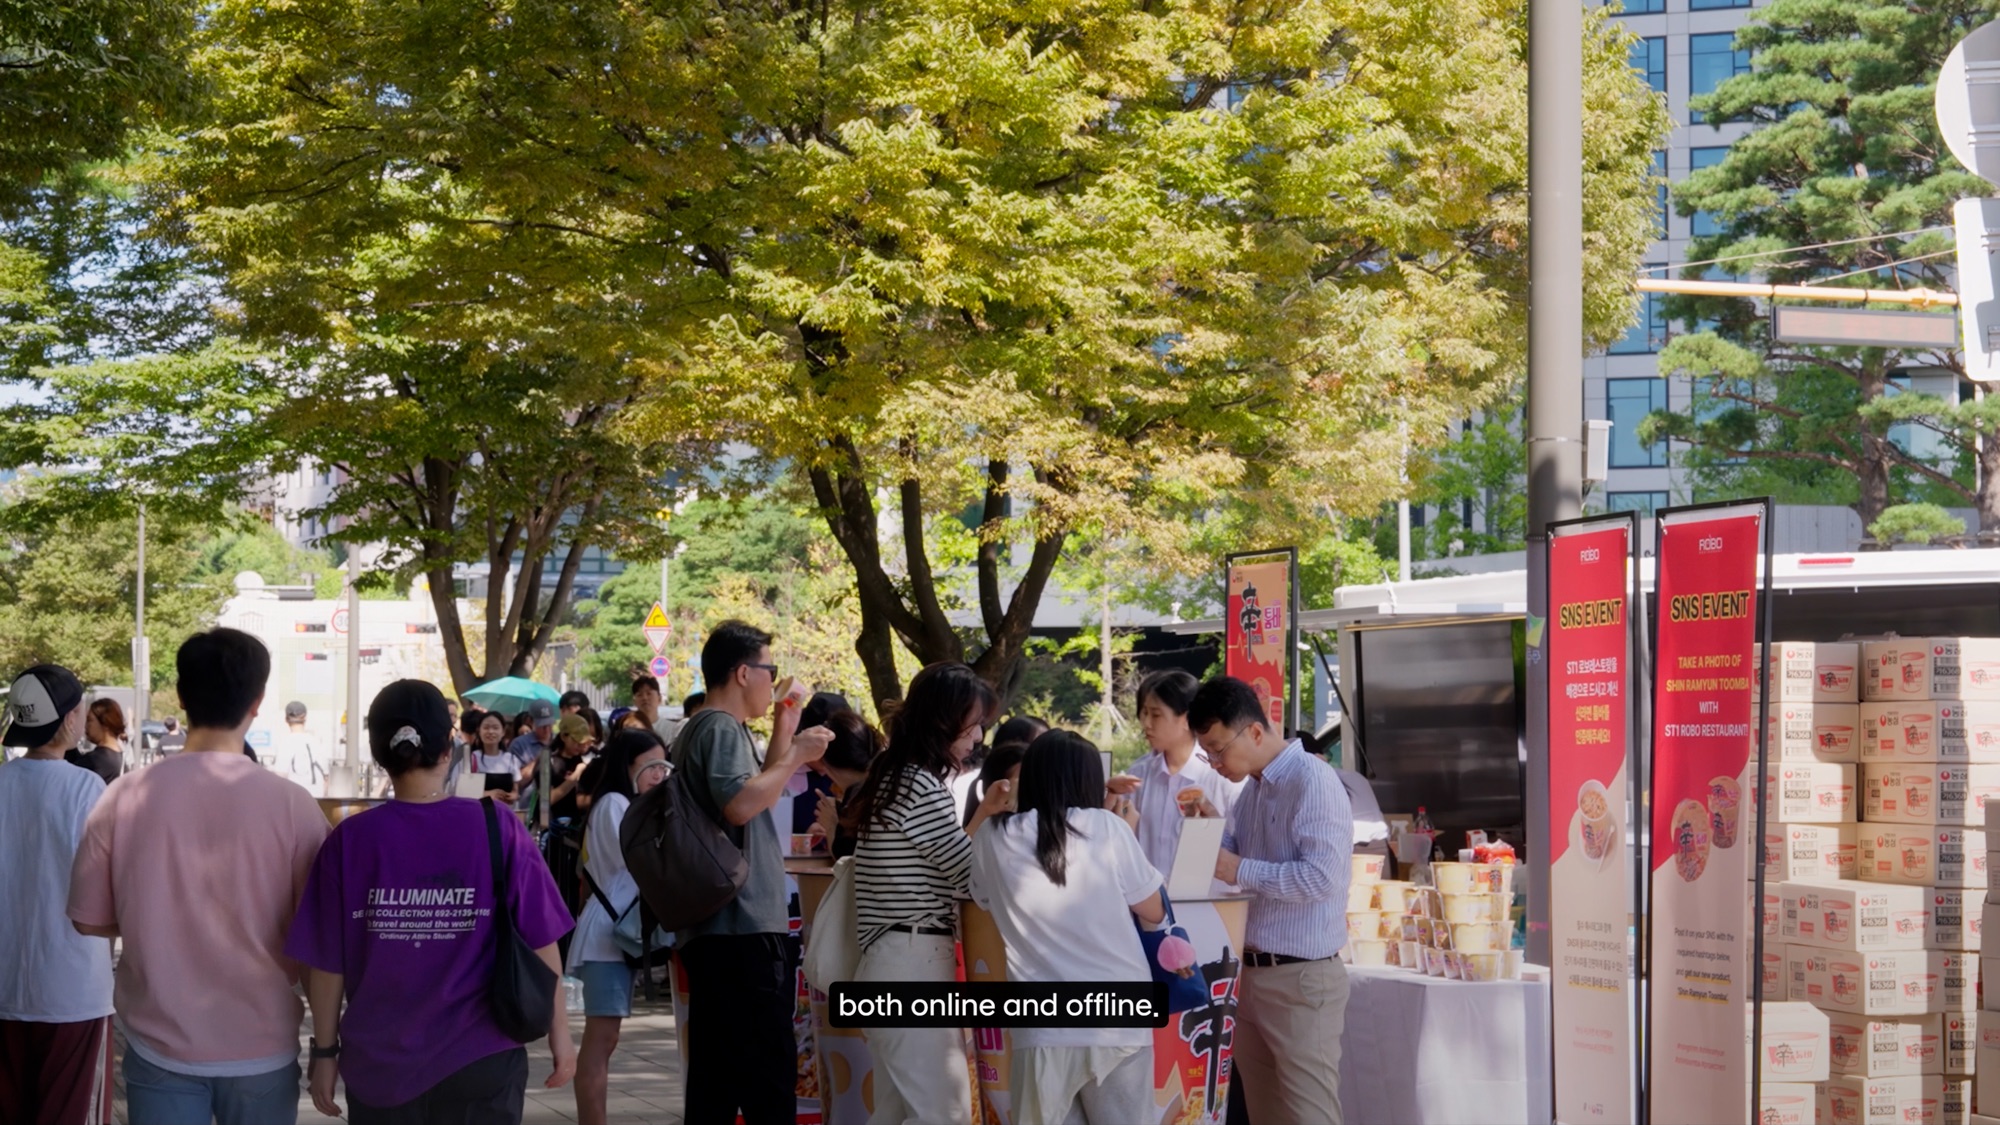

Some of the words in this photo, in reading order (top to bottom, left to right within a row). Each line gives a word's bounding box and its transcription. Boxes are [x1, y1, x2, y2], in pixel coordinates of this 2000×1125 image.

[1671, 594, 1699, 622] SNS
[1701, 590, 1750, 620] EVENT
[1560, 603, 1582, 629] SNS
[1584, 598, 1622, 627] EVENT
[1566, 661, 1578, 675] ST1
[1678, 656, 1696, 668] TAKE
[1698, 656, 1703, 668] A
[1705, 655, 1730, 668] PHOTO
[1731, 655, 1741, 666] OF
[1666, 680, 1684, 692] SHIN
[1686, 679, 1717, 691] RAMYUN
[1719, 678, 1749, 690] TOOMBA
[1699, 701, 1718, 714] WITH
[1665, 724, 1679, 737] ST1
[1680, 724, 1700, 737] ROBO
[376, 909, 433, 918] COLLECTION
[372, 920, 398, 928] travel
[400, 920, 433, 928] around
[434, 920, 449, 928] the
[379, 933, 410, 941] Ordinary
